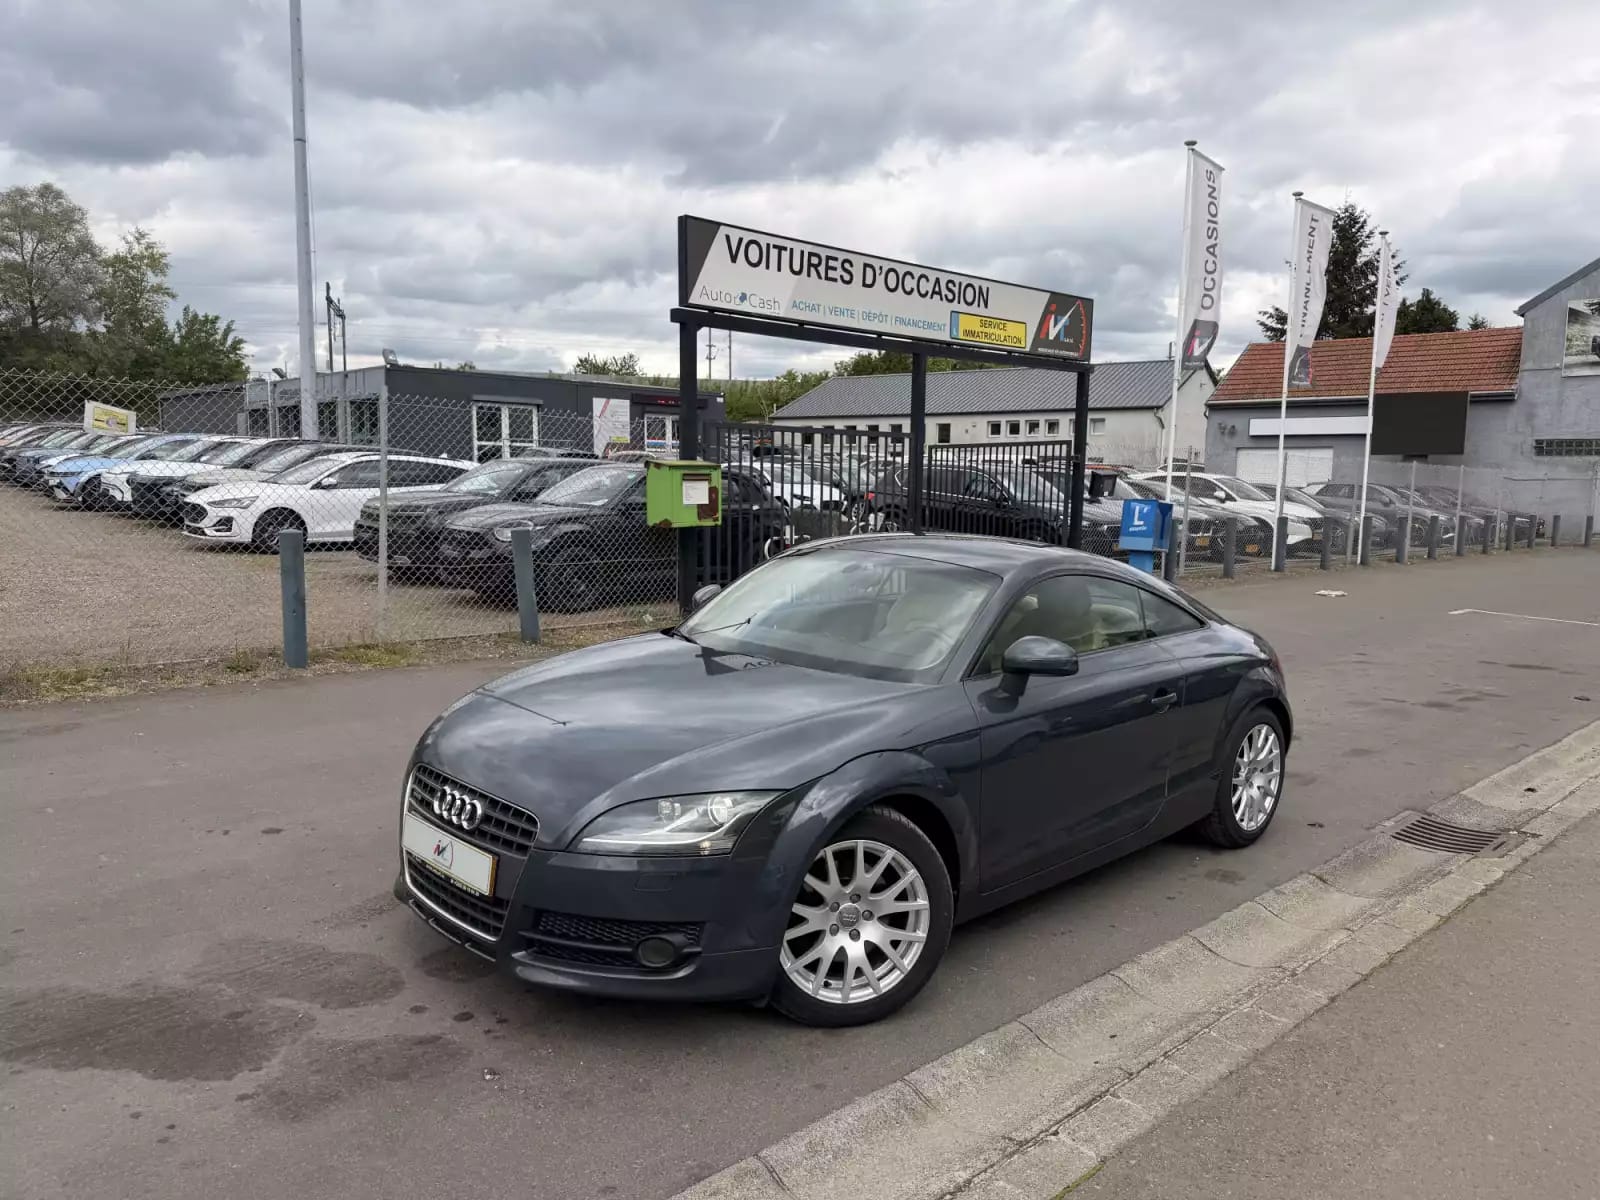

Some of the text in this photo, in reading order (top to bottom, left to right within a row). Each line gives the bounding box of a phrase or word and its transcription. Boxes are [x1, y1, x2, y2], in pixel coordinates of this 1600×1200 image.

[1200, 168, 1218, 311] OCCASIONS
[725, 233, 990, 309] VOITURES D'OCCASION
[1299, 213, 1320, 338] INANMENT
[699, 285, 781, 311] Auto Cash
[791, 300, 947, 332] ACHAT VENTE DÉPÔT FINANCEMENT
[979, 319, 1007, 332] SERVICE
[962, 329, 1022, 345] IMMATRICULATION
